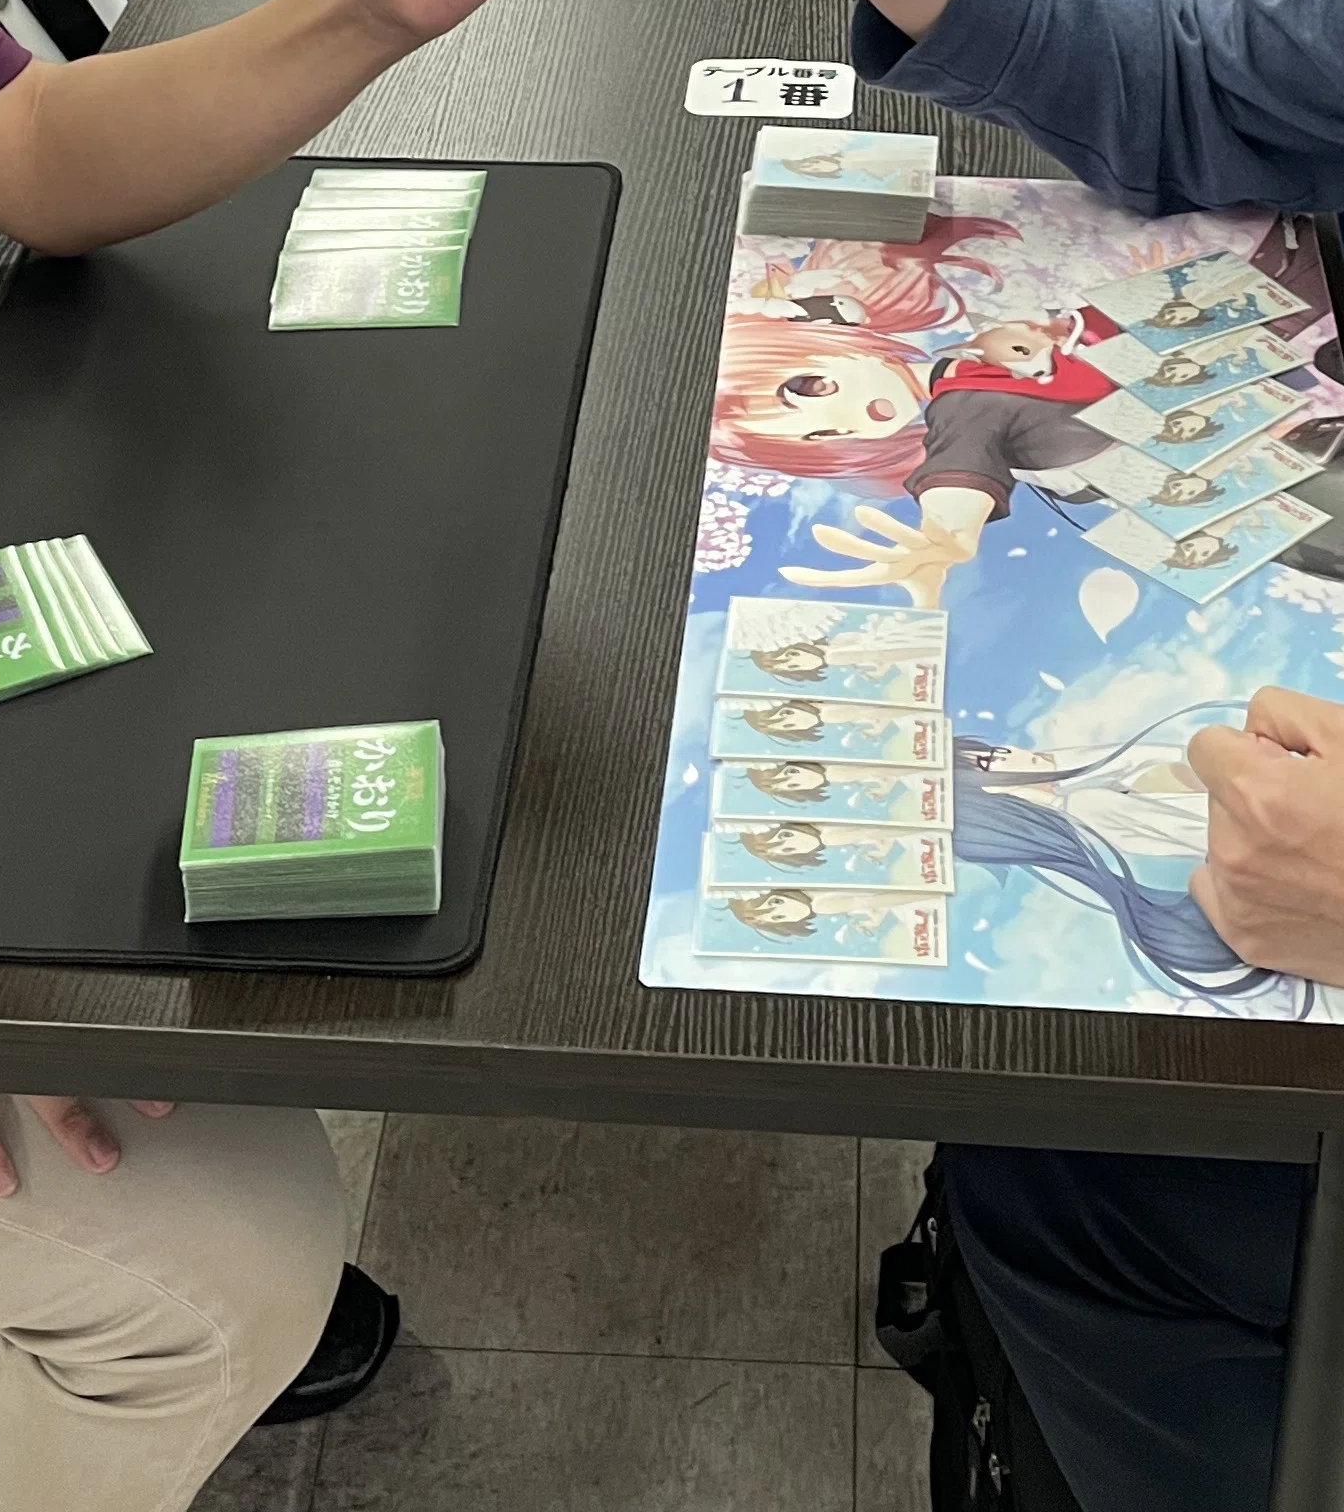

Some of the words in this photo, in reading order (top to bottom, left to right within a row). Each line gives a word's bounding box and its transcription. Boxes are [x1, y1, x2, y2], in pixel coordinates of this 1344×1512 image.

[703, 65, 840, 80] テーブル番号
[346, 737, 397, 833] かおり
